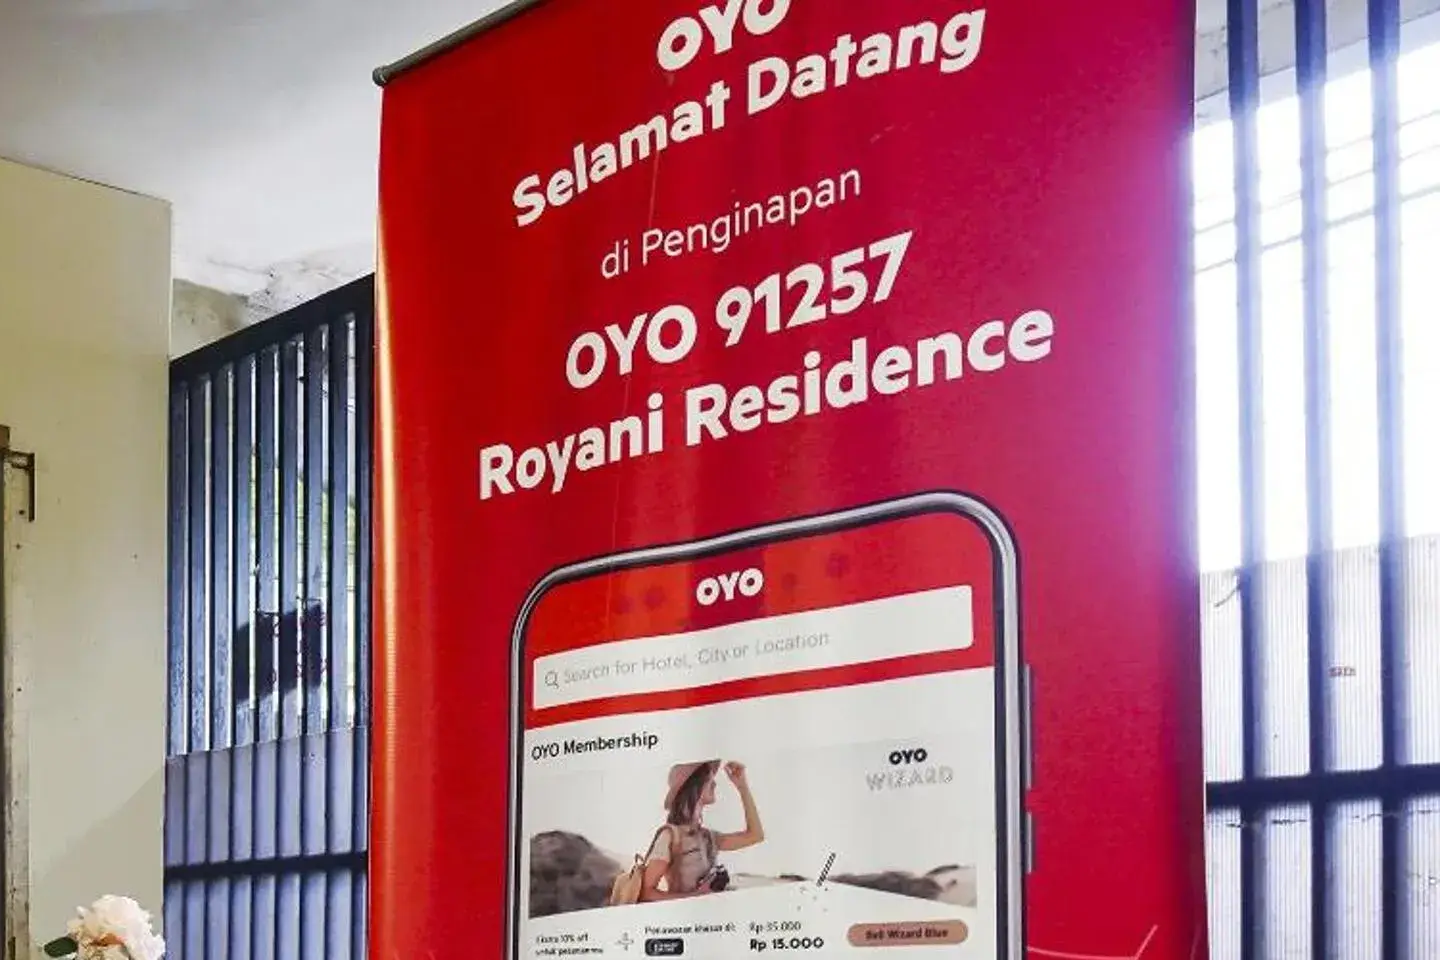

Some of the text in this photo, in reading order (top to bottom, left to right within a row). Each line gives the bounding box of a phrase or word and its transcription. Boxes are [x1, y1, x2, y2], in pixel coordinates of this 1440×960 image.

[657, 0, 791, 72] OYO
[512, 9, 986, 227] Selamat Datang
[601, 168, 861, 279] di Penginapan
[565, 231, 913, 389] OYO 91257
[479, 309, 1054, 500] Royani Residence
[696, 568, 764, 606] OYO
[563, 663, 610, 685] Search
[615, 660, 638, 675] for
[698, 648, 729, 666] City
[732, 645, 749, 658] or
[756, 631, 830, 650] Location
[531, 731, 658, 760] OYO Membership
[889, 748, 927, 765] OYO
[866, 766, 953, 791] WIZARD
[750, 937, 824, 951] Rp 15.000
[888, 928, 922, 940] Wizard
